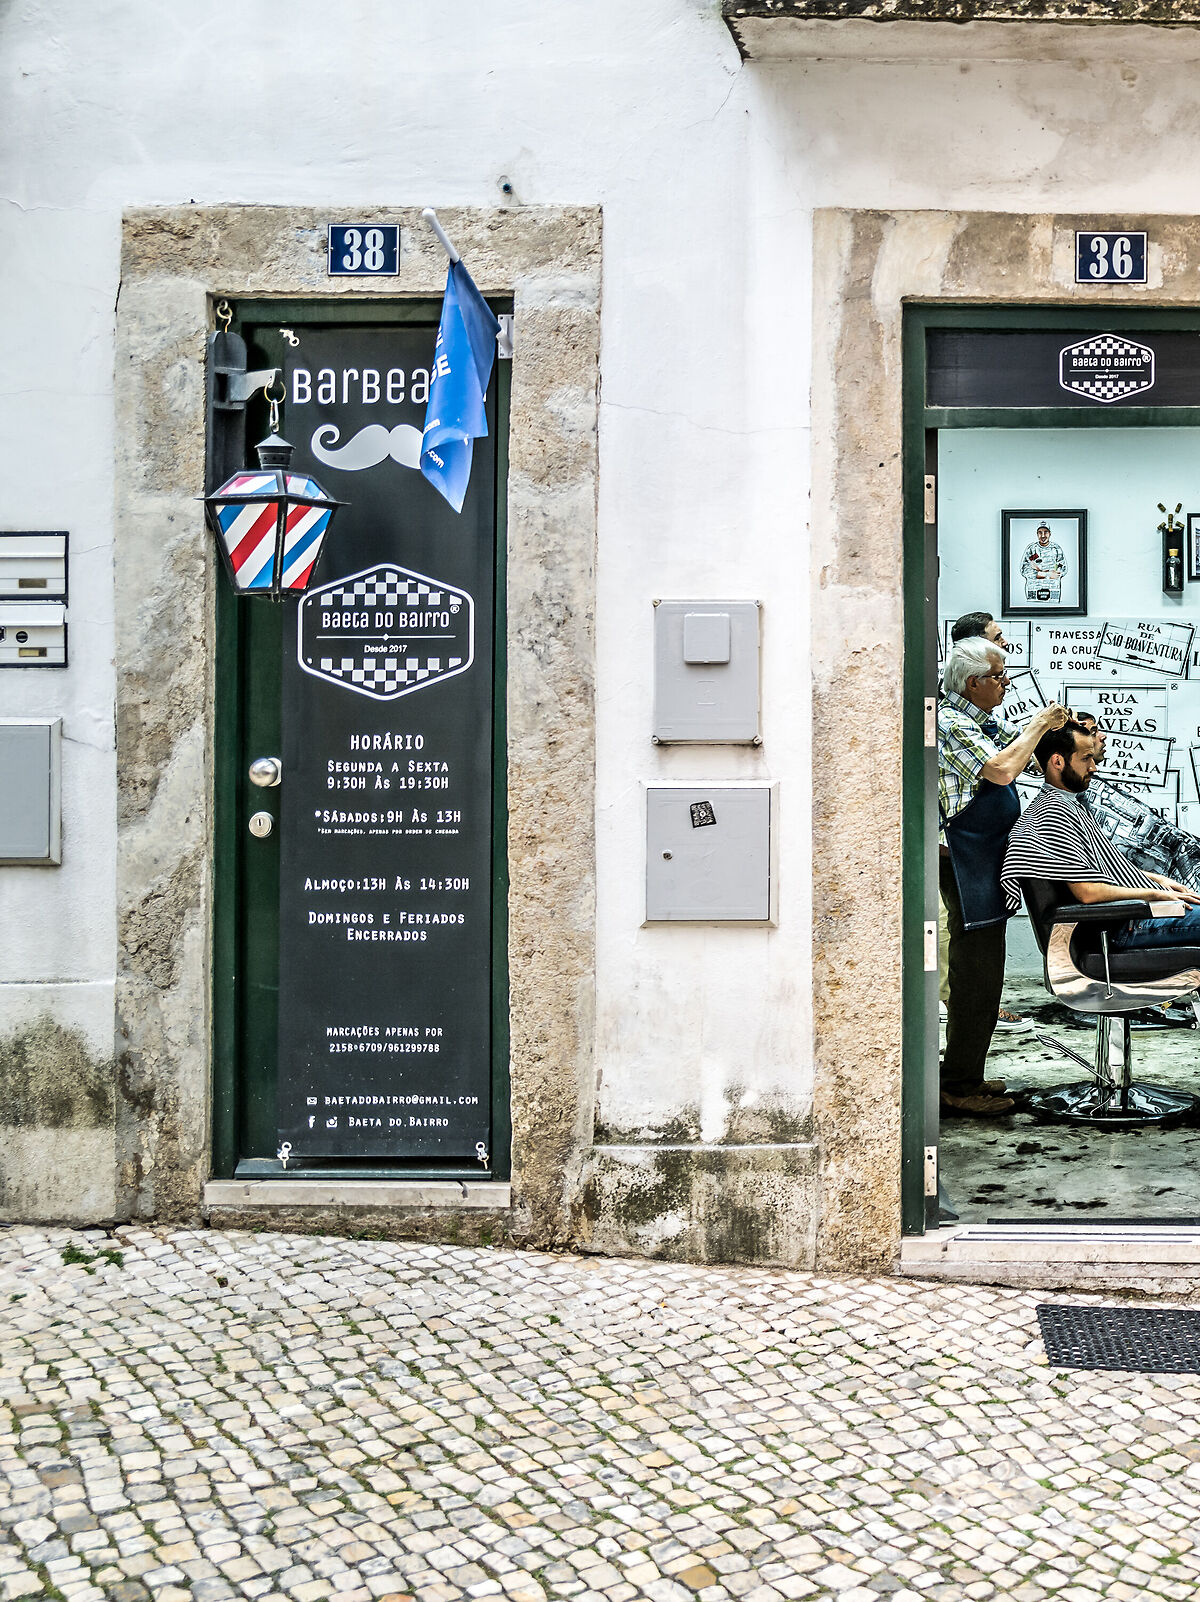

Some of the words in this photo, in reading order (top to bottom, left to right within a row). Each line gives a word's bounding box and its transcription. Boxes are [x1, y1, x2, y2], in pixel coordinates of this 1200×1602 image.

[342, 228, 384, 271] 38
[1089, 236, 1133, 278] 36
[1138, 622, 1162, 634] RUA
[1049, 630, 1101, 640] TRAVESSA
[1140, 632, 1154, 640] DE
[364, 644, 388, 654] Desde
[389, 644, 408, 654] 2017
[1052, 646, 1067, 654] DA
[1072, 646, 1098, 654] CRUZ
[1050, 661, 1062, 670] DE
[1068, 661, 1102, 670] SOURE
[1098, 693, 1138, 704] RUA
[1104, 707, 1134, 716] DAS
[350, 732, 424, 750] HORÁRIO
[1112, 738, 1146, 752] RUA
[1118, 751, 1134, 760] DA
[327, 776, 366, 790] 9:30H
[400, 776, 449, 790] 19:30H
[436, 810, 461, 823] 13H
[420, 878, 470, 890] 14:30H
[326, 1026, 380, 1038] MARCAÇÕES
[385, 1027, 420, 1036] APENAS
[426, 1027, 443, 1036] POR
